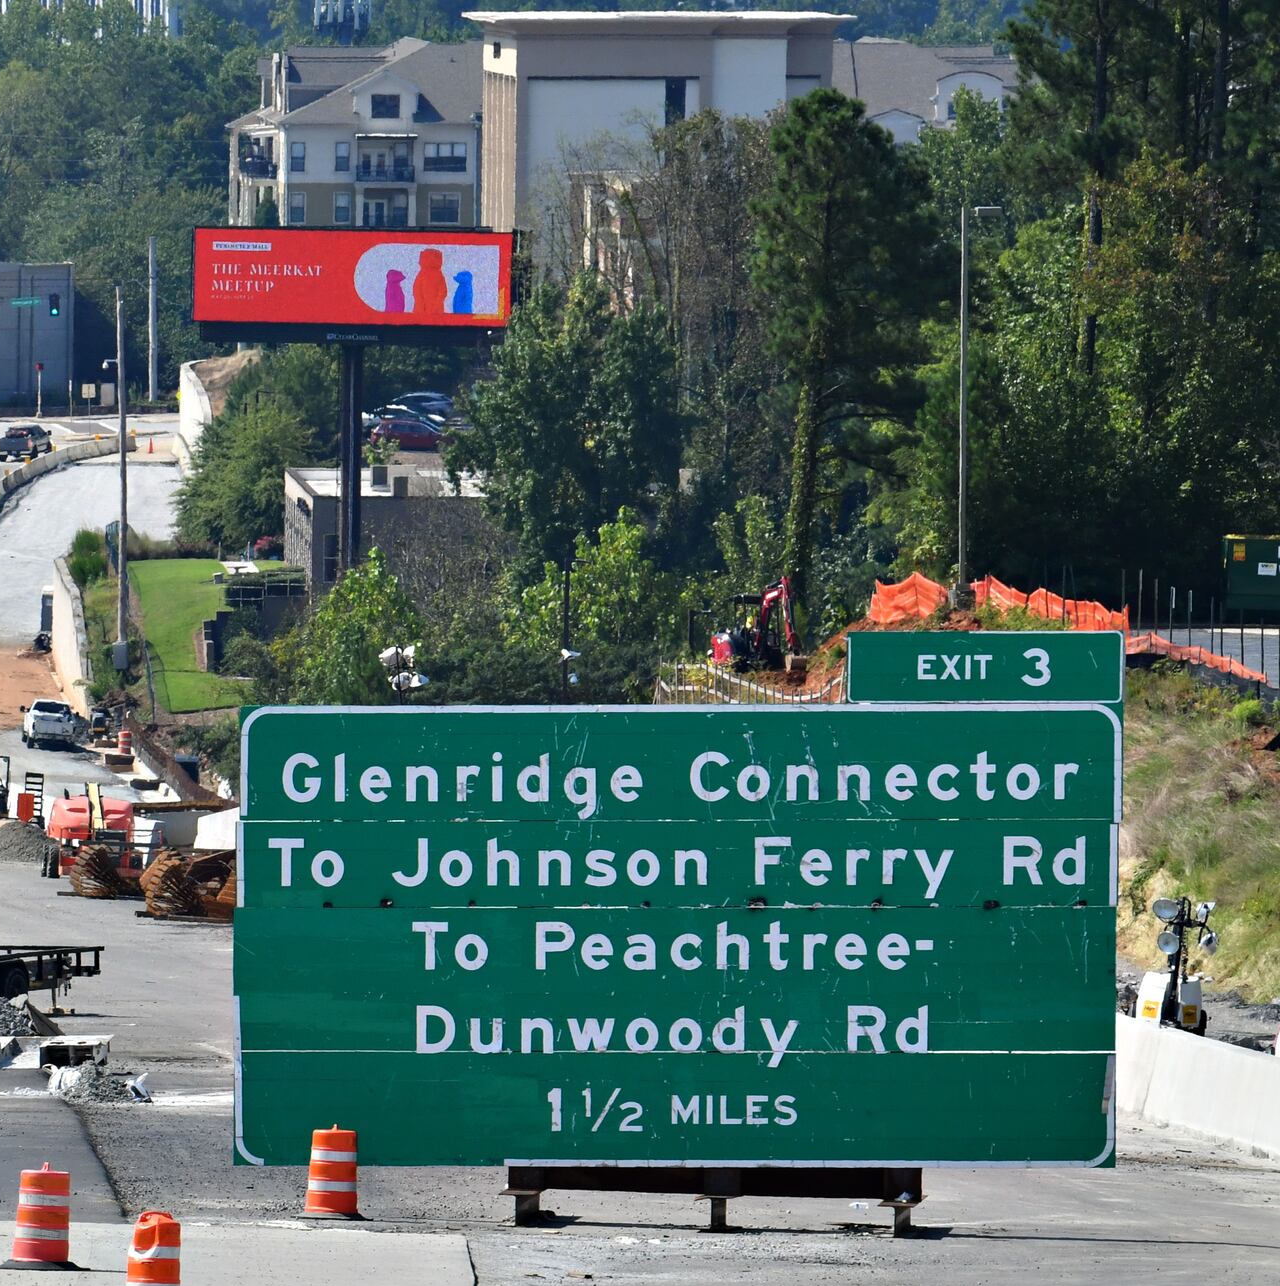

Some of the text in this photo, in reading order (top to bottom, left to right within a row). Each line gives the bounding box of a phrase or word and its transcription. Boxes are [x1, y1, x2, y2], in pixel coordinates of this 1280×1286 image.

[211, 280, 275, 293] MEETUP
[212, 263, 323, 277] THE MEERKAT
[917, 647, 1051, 687] EXIT 3
[282, 750, 1080, 821] Glenridge Connector
[268, 835, 1086, 899] To Johnson Ferry Rd
[411, 920, 934, 971] To Peachtree-
[414, 1004, 930, 1068] Dunwoody Rd
[671, 1094, 798, 1126] MILES
